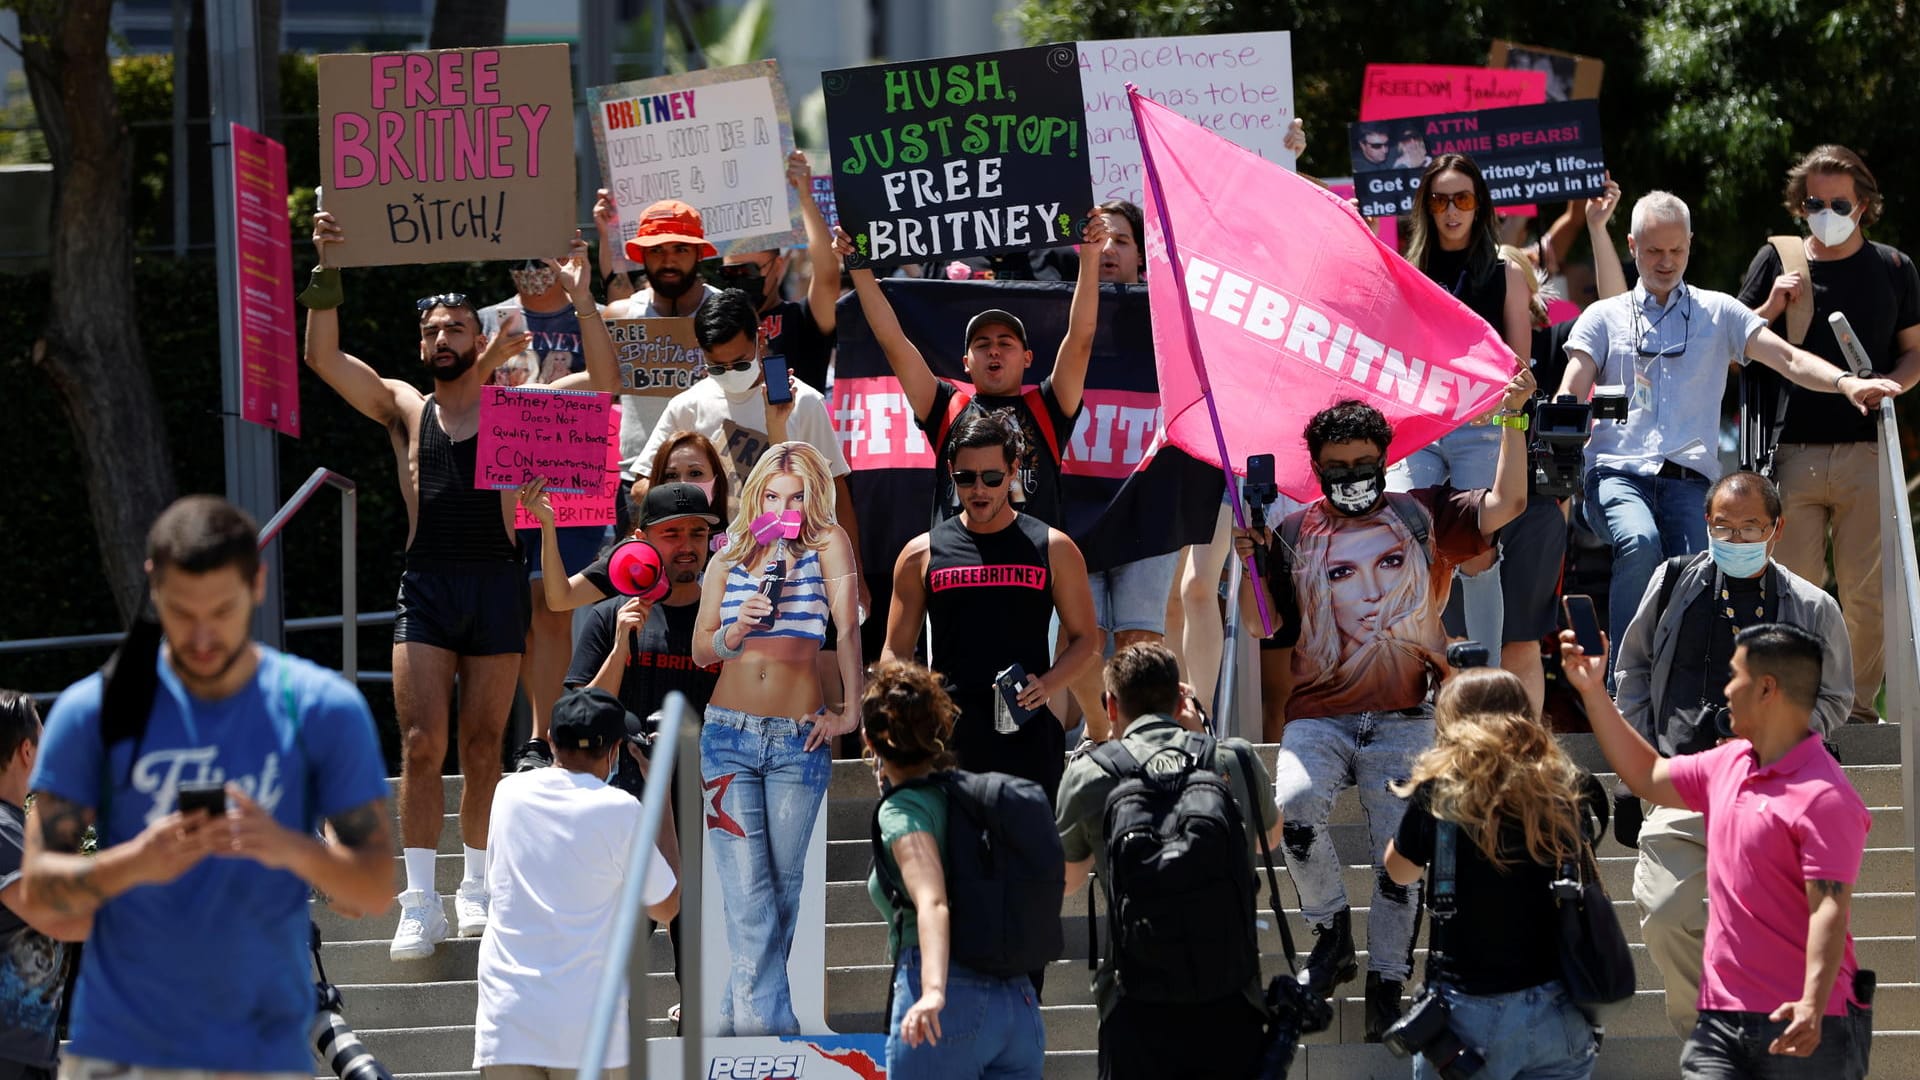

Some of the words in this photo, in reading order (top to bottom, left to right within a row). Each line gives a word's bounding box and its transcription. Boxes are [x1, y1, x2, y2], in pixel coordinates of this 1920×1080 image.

[1101, 45, 1262, 73] Racehorse
[371, 50, 500, 109] FREE
[884, 60, 1017, 113] HUSH,
[1149, 87, 1199, 106] has
[606, 90, 696, 130] BRITNEY
[1426, 117, 1479, 135] ATTN
[333, 104, 551, 189] BRITNEY
[609, 134, 662, 168] WILL
[667, 125, 710, 160] NOT
[717, 120, 745, 152] BE
[754, 117, 770, 145] A
[842, 116, 953, 174] JUST
[961, 114, 1078, 158] STOP!
[1431, 138, 1492, 156] JAMIE
[1496, 126, 1580, 149] SPEARS!
[614, 169, 683, 208] SLAVE
[690, 166, 706, 194] 4
[723, 160, 738, 188] U
[882, 157, 1003, 212] FREE
[1369, 177, 1403, 194] Get
[1481, 160, 1552, 179] ritney's
[1556, 156, 1604, 173] life...
[1363, 201, 1397, 216] she
[1490, 182, 1522, 200] ant
[1525, 181, 1559, 199] you
[1564, 176, 1582, 191] in
[866, 202, 1061, 261] BRITNEY
[491, 390, 548, 409] Britney
[553, 394, 602, 413] Spears
[521, 411, 550, 422] Does
[556, 413, 577, 425] Not
[492, 426, 530, 442] Qualify
[535, 429, 552, 441] For
[556, 432, 562, 442] A
[485, 466, 513, 483] Free
[571, 473, 602, 489] Now!
[933, 567, 1045, 589] #FREEBRITNEY
[709, 1056, 806, 1080] PEPSI
